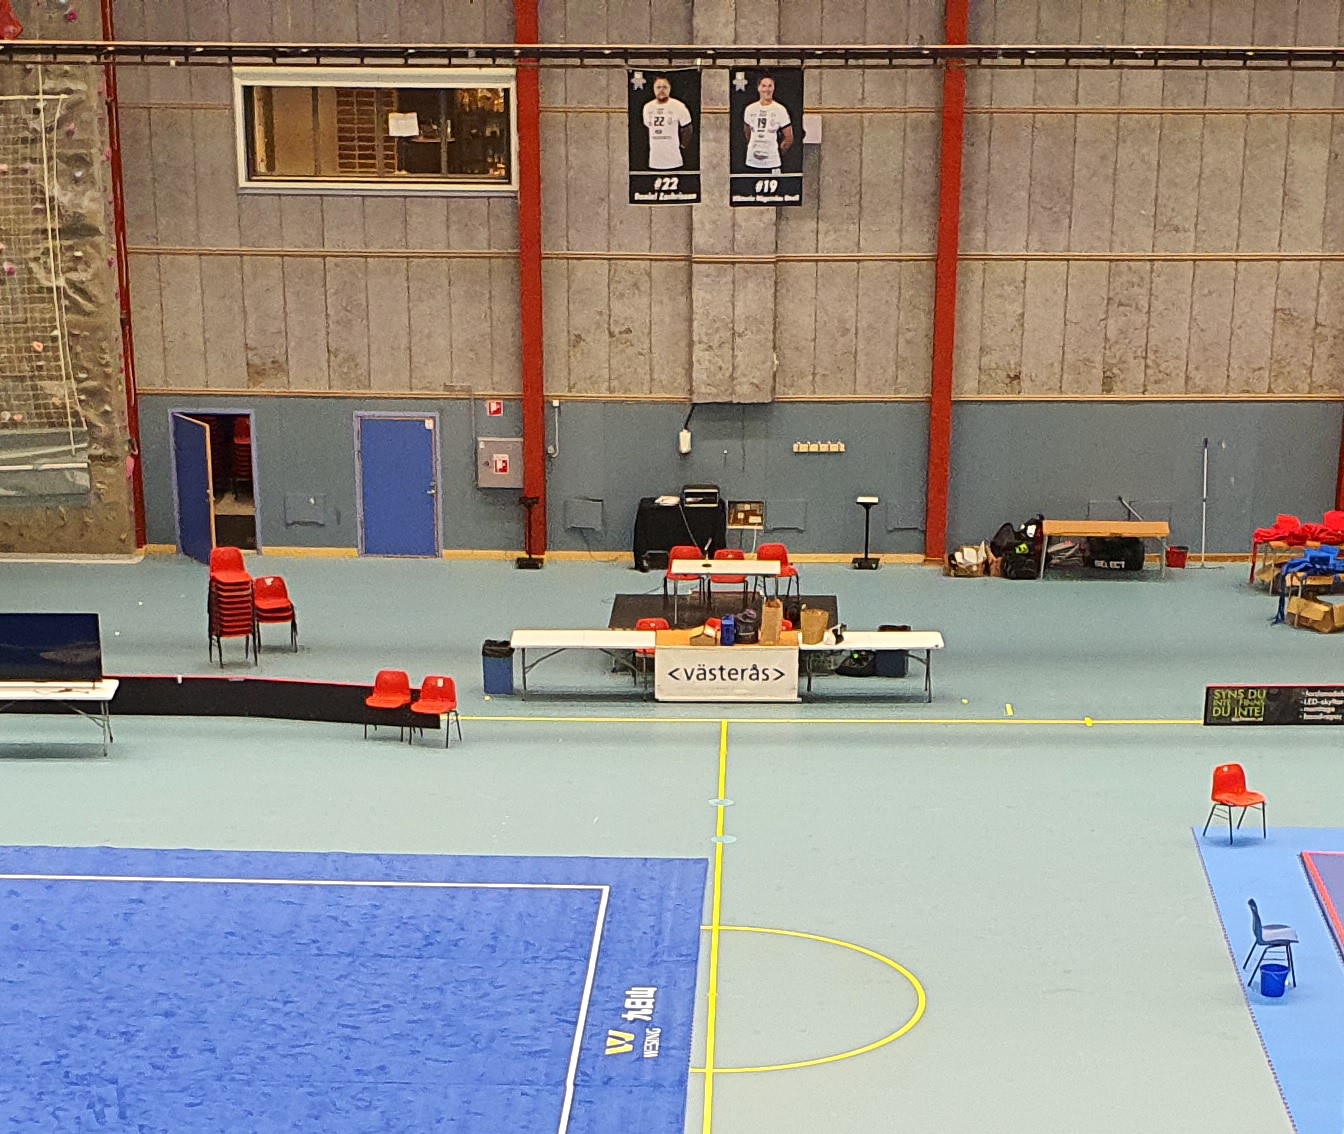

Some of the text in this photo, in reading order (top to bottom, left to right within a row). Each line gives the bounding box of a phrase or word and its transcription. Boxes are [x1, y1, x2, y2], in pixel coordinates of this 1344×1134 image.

[654, 116, 665, 127] 22
[757, 117, 767, 129] 19
[654, 177, 679, 190] #22
[755, 179, 778, 193] #19
[1213, 689, 1267, 700] SYNS DU
[1212, 707, 1232, 717] DU
